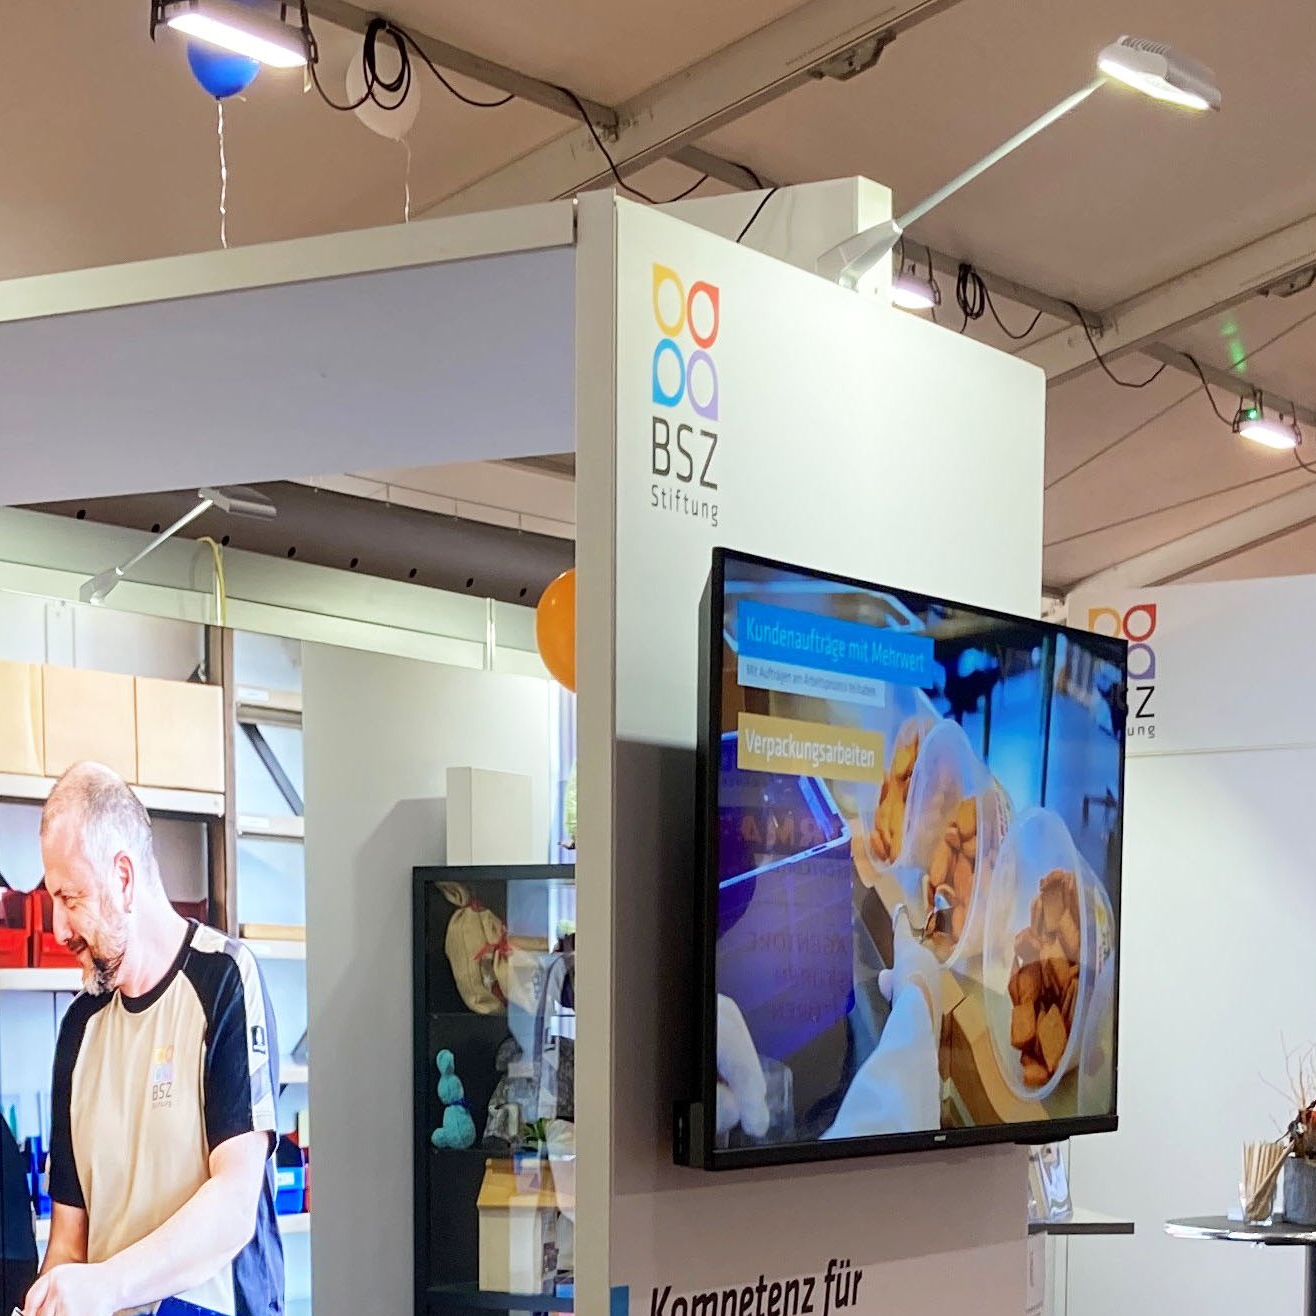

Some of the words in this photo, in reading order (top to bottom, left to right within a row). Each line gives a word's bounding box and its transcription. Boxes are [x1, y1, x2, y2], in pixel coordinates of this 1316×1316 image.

[652, 415, 718, 491] BSZ
[651, 484, 718, 527] Stiftung
[848, 638, 868, 662] mit
[871, 641, 925, 673] Mehrwert
[745, 729, 875, 768] Verpackungsarbeiten
[152, 1081, 172, 1102] BSZ
